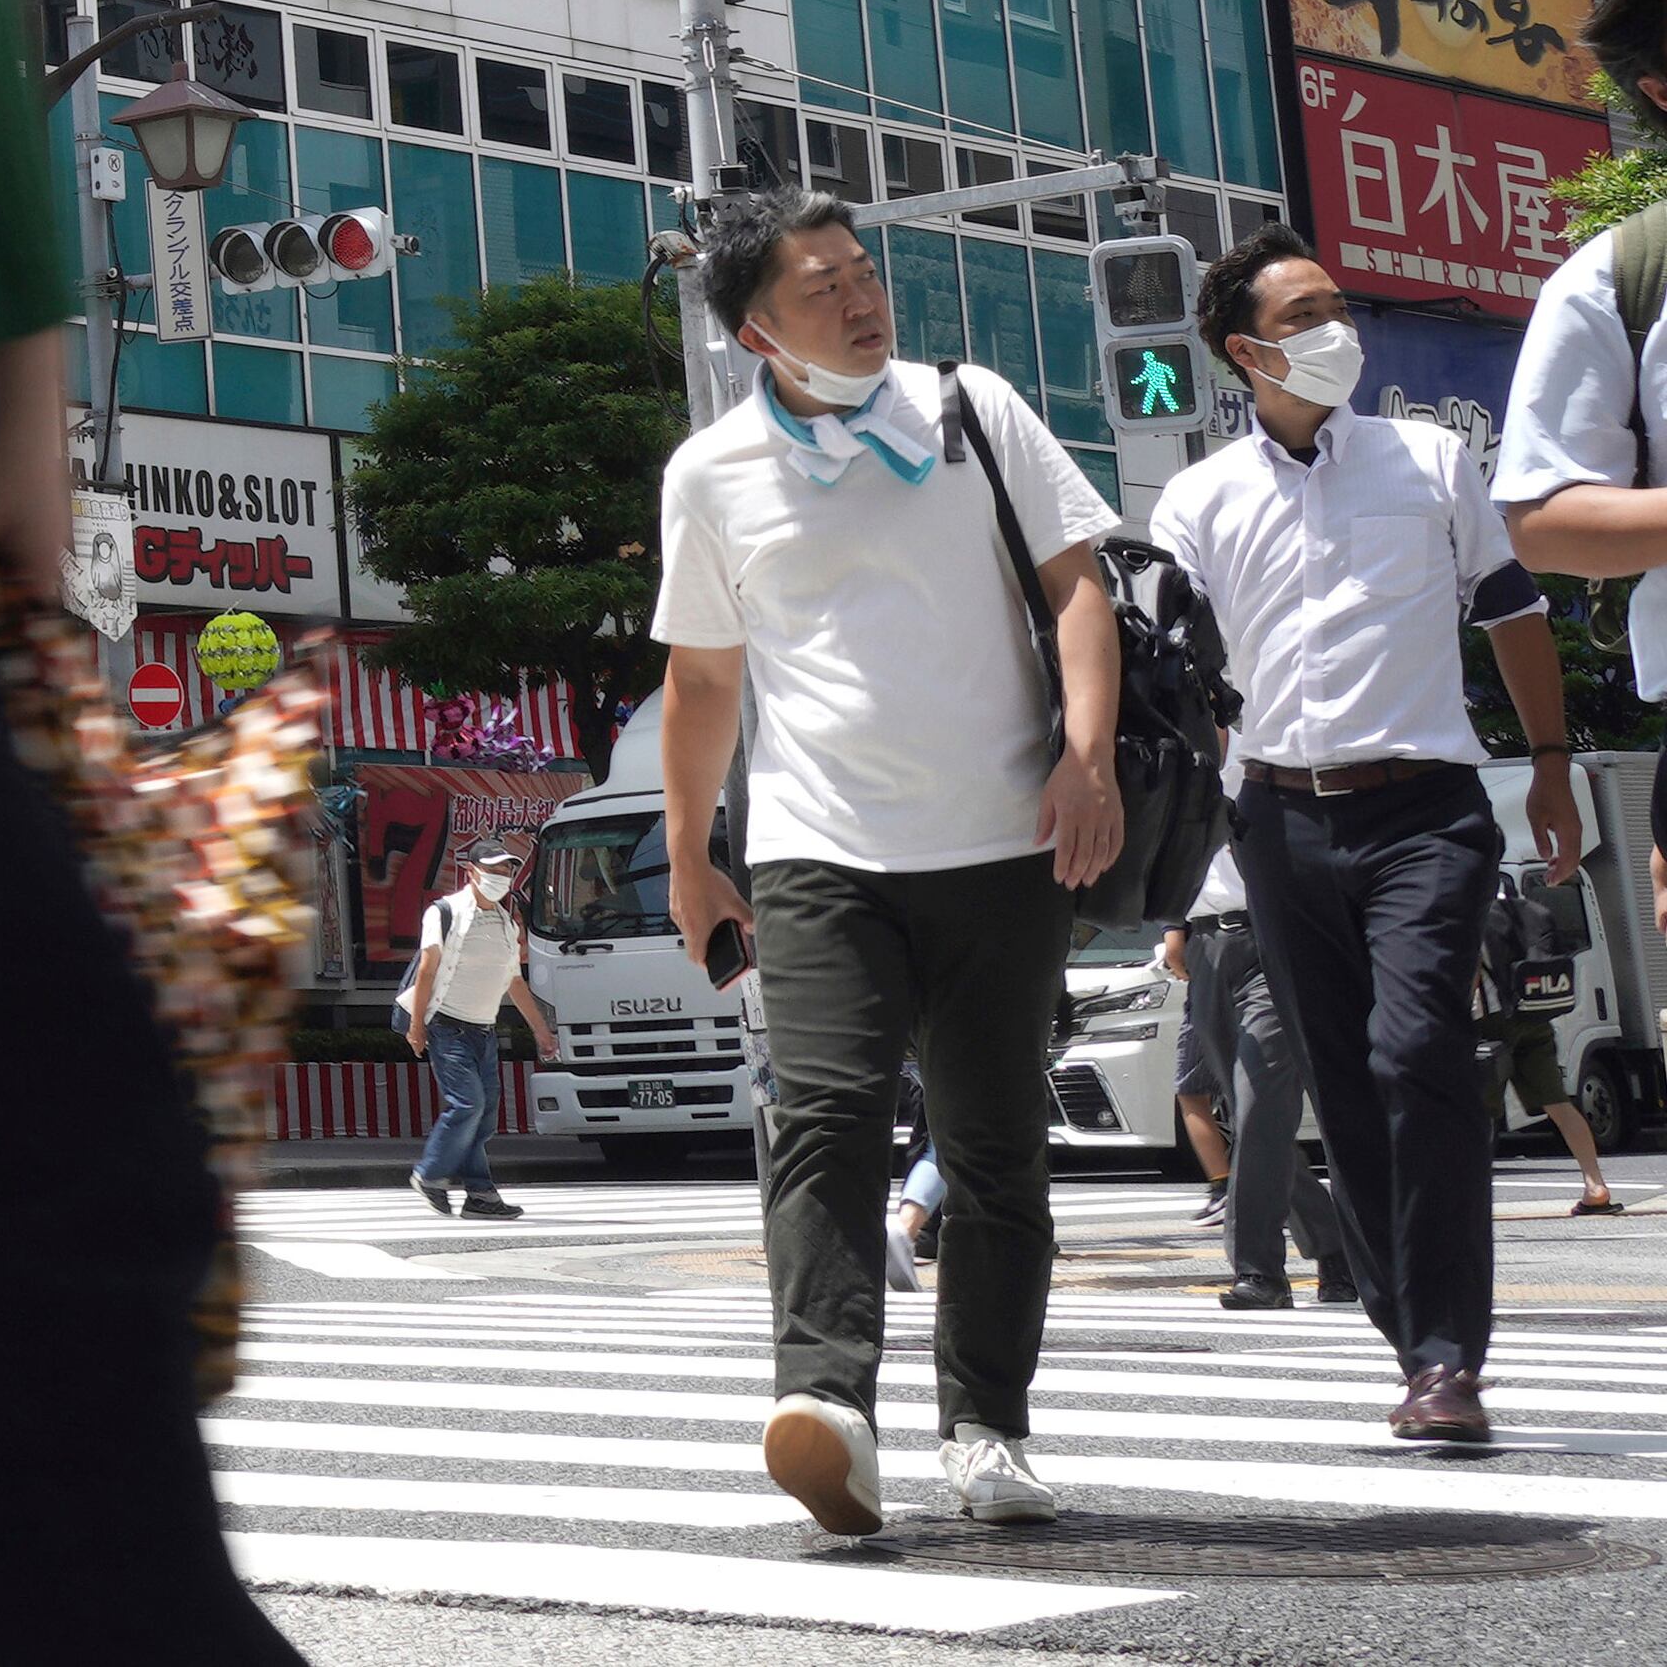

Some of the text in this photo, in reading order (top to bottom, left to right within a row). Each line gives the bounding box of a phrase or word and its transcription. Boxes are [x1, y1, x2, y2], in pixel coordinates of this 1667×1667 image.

[1298, 65, 1337, 110] 6F
[1339, 90, 1566, 265] 白木屋
[1524, 972, 1571, 996] FILA
[610, 996, 682, 1016] ISUZU
[638, 1090, 673, 1106] 77-05
